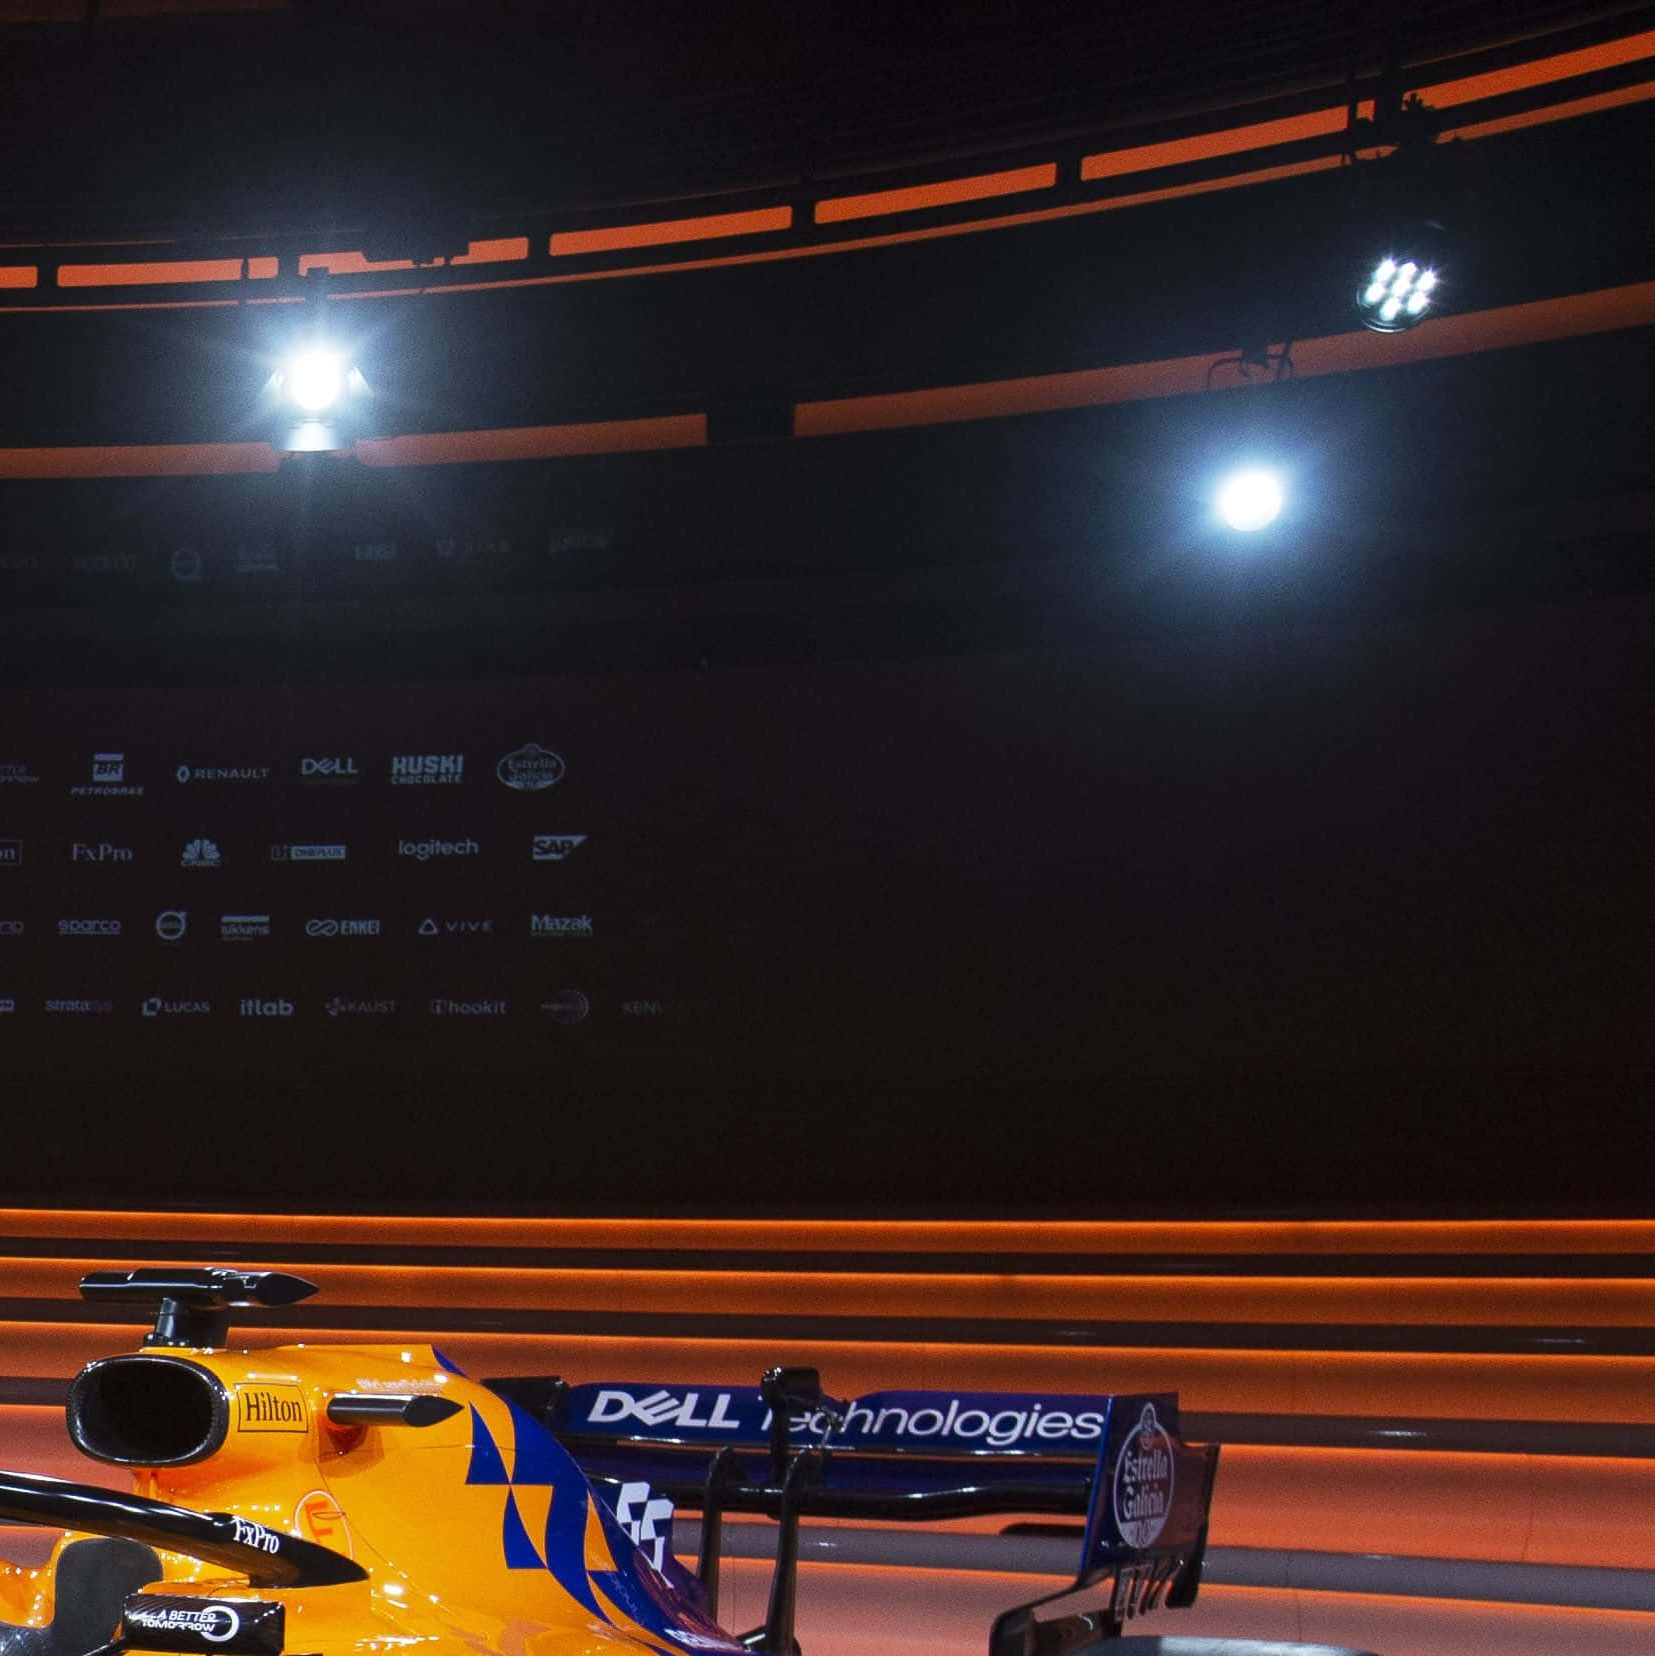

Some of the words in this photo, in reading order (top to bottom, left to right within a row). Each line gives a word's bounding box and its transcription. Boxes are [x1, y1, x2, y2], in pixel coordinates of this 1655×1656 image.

[194, 767, 271, 780] RENAULT
[301, 757, 359, 776] DELL
[391, 755, 464, 775] HUSKI
[391, 775, 461, 785] CHOCOLATE
[72, 843, 133, 862] FxPro
[398, 838, 479, 862] logitech
[445, 920, 493, 932] VIVE
[531, 914, 593, 931] Mazak
[164, 1001, 210, 1014] LUCAS
[448, 1000, 505, 1015] hookit
[244, 1391, 303, 1424] Hilton
[586, 1390, 741, 1430] DELL
[231, 1516, 281, 1555] FxPro
[168, 1610, 217, 1623] BETTER
[141, 1618, 217, 1633] TOMORROW
